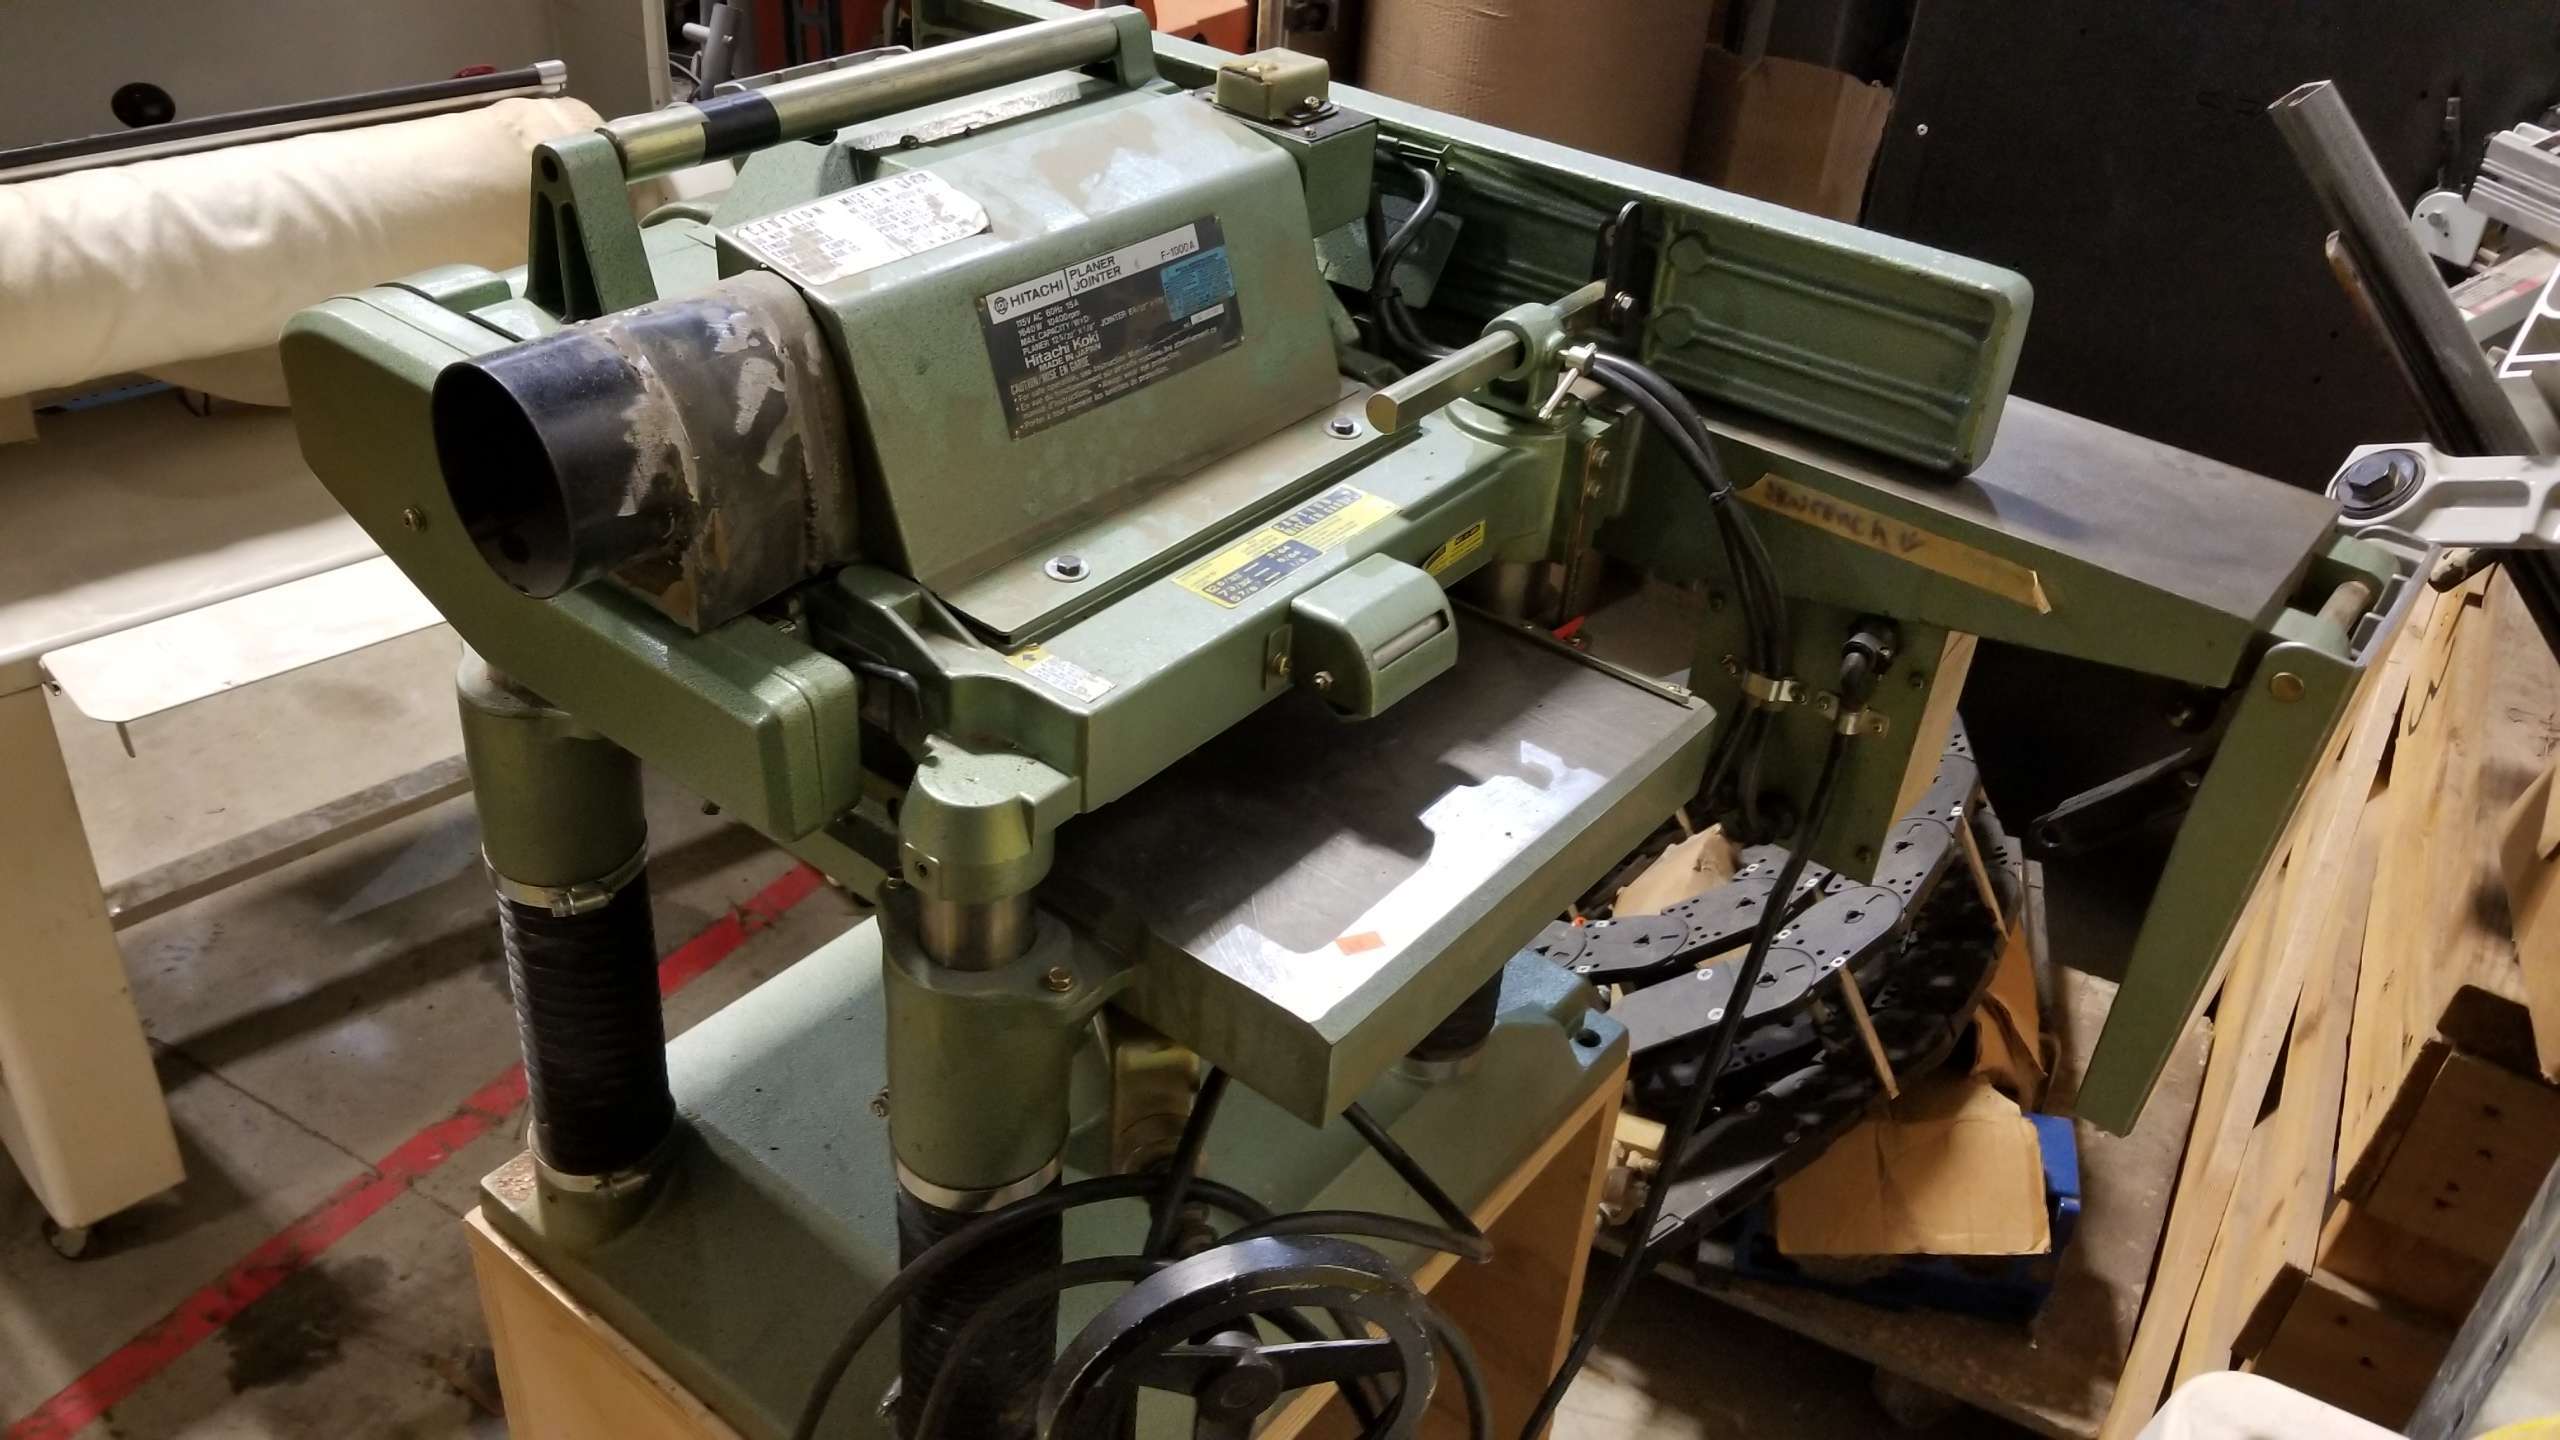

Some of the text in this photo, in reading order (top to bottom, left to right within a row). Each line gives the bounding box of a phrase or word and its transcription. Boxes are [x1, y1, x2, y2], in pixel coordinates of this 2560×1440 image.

[1160, 239, 1195, 260] F-1000A
[1068, 255, 1115, 280] PLANER
[1071, 265, 1121, 292] JOINTER
[1009, 278, 1064, 308] HITACHI
[1032, 311, 1043, 321] AC
[1045, 304, 1063, 317] 60Hz
[1038, 321, 1069, 339] CAPACITY
[1022, 339, 1049, 356] PLANER
[1024, 329, 1099, 369] Hitachi Koki
[1038, 356, 1063, 372] MADE
